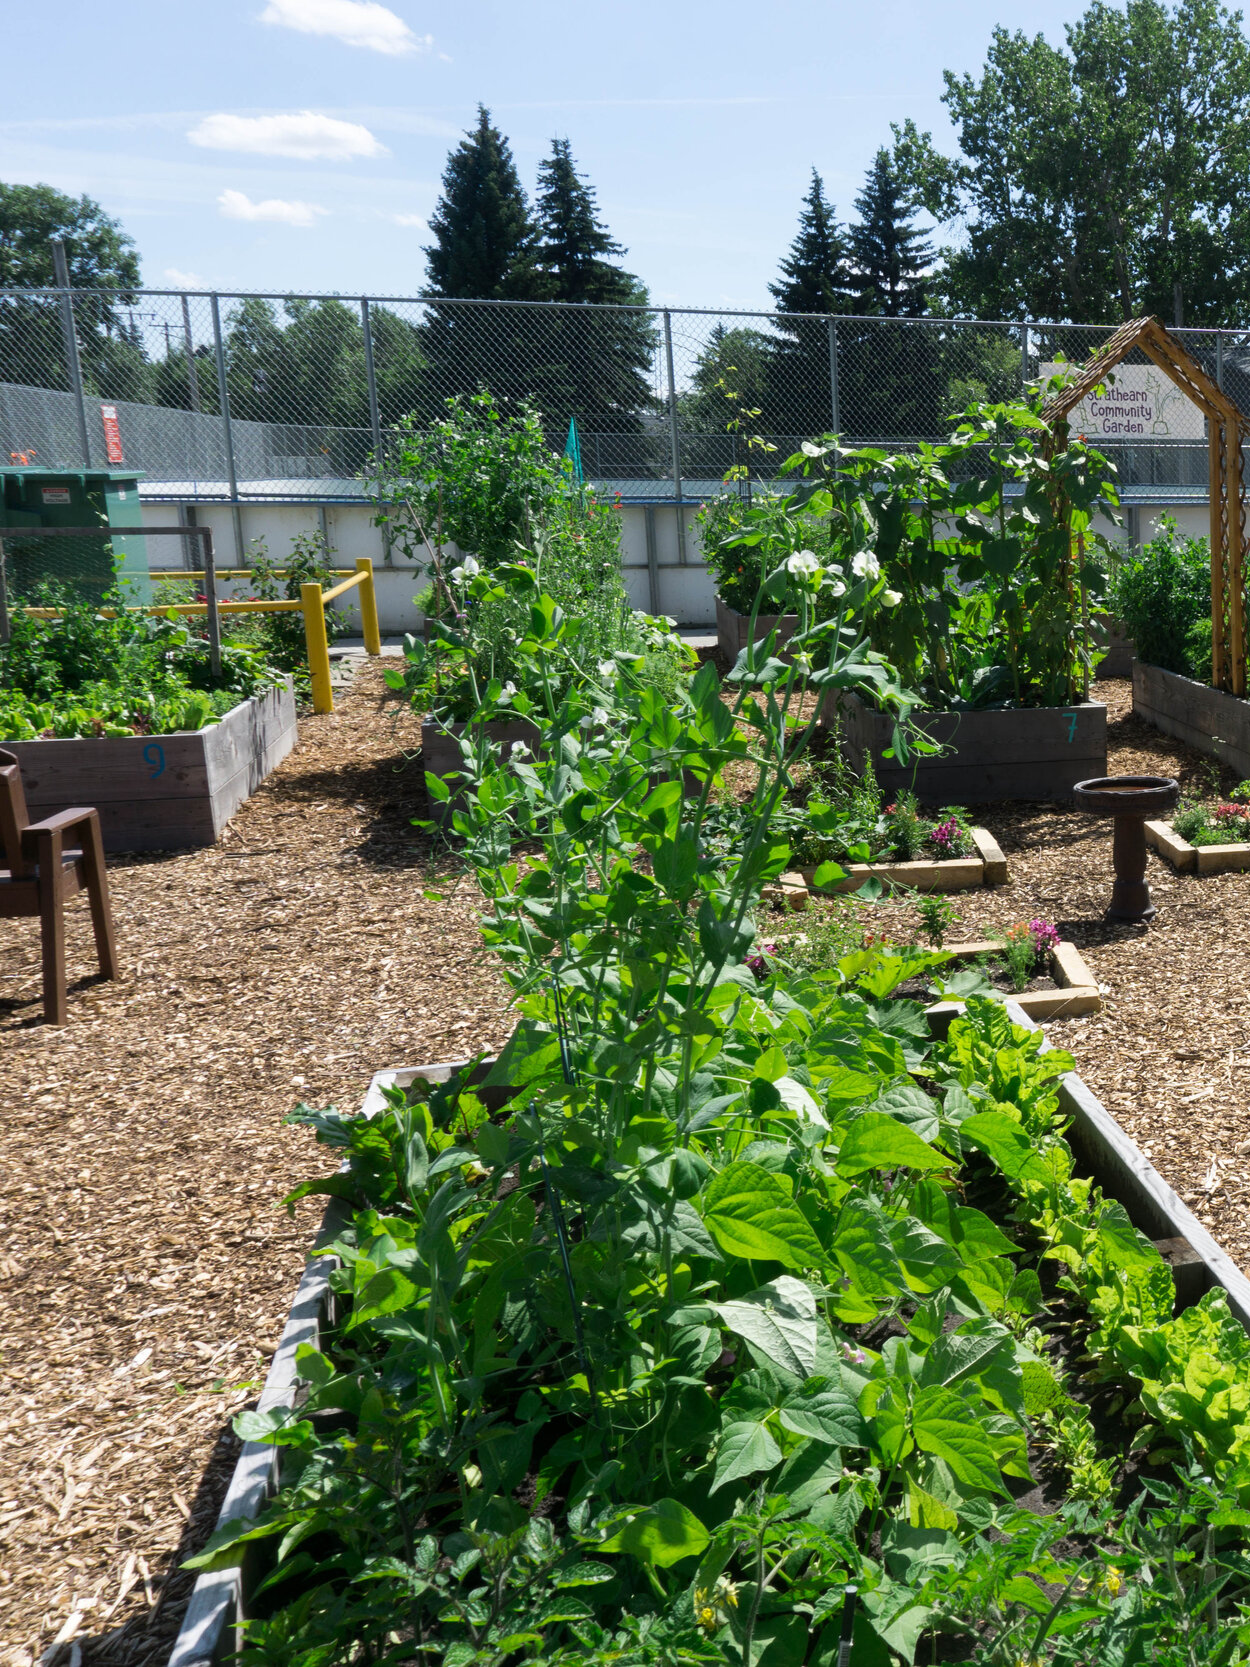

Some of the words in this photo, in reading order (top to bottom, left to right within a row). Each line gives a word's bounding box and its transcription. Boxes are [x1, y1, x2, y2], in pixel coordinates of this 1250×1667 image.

[1087, 387, 1148, 402] Stathearn
[1090, 402, 1152, 421] Community
[1102, 418, 1144, 433] Garden
[1061, 712, 1078, 743] 7
[143, 743, 166, 779] 9
